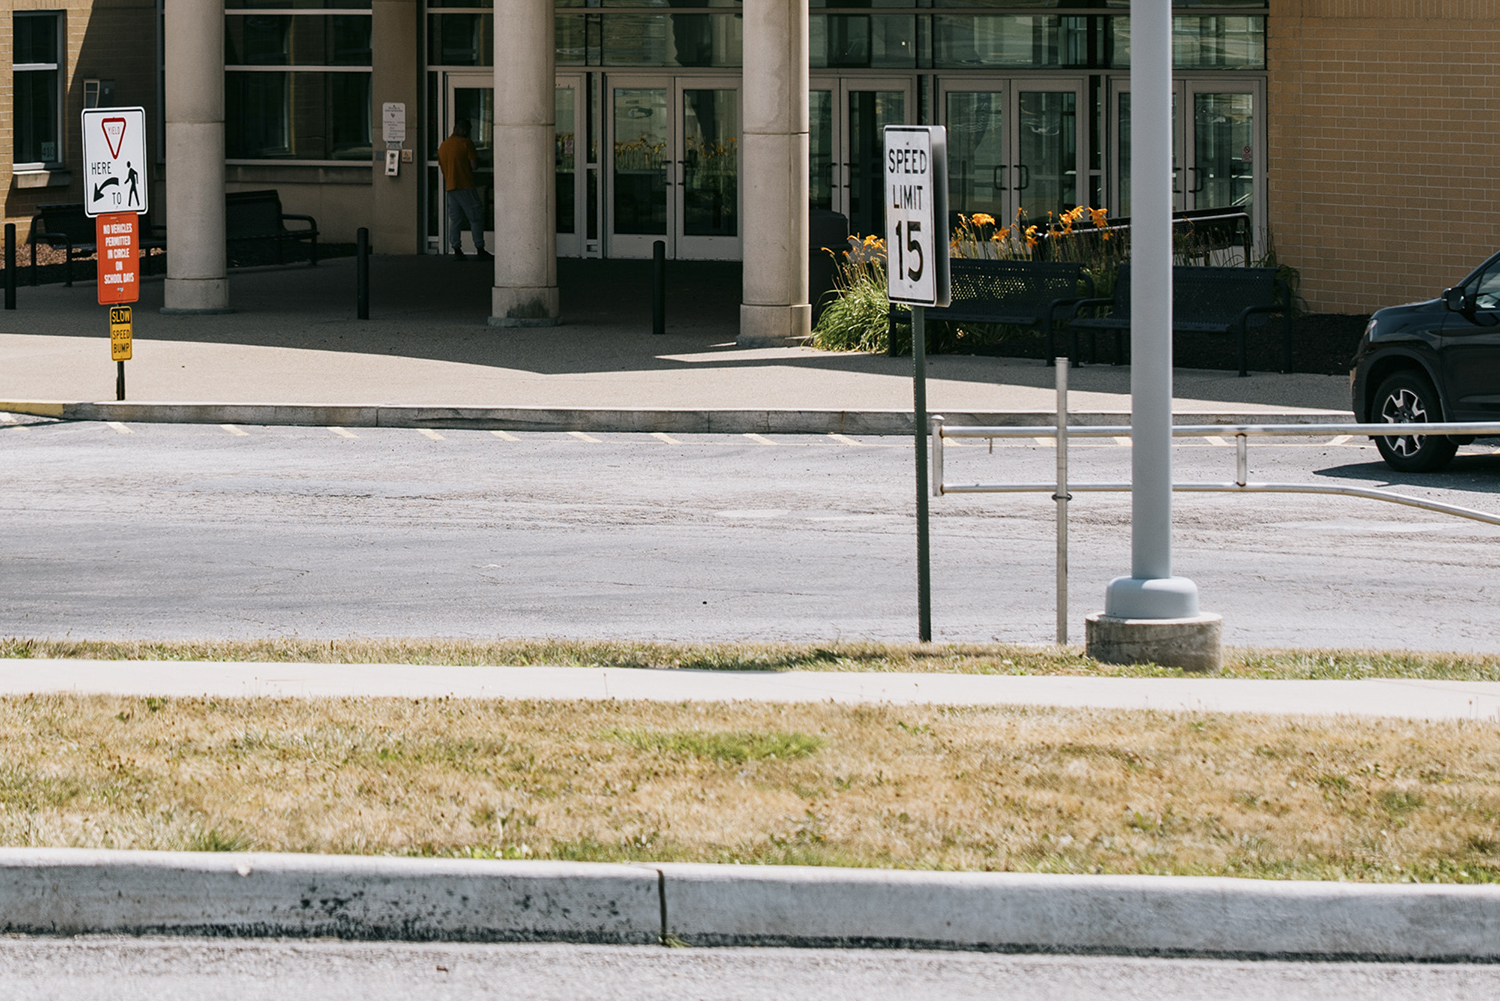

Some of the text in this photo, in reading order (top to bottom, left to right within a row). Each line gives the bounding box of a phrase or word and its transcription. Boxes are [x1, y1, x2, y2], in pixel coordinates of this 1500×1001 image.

[108, 126, 120, 135] YIELD
[888, 148, 927, 175] SPEED
[91, 161, 112, 175] HERE
[112, 192, 122, 205] TO
[892, 184, 923, 210] LIMIT
[103, 223, 133, 235] NO VEHICLES
[105, 235, 131, 247] PERMITTED
[107, 248, 130, 259] IN CIRCLE
[895, 220, 924, 283] 15
[115, 261, 123, 271] ON
[104, 272, 134, 285] SCHOOL DAYS
[112, 310, 130, 323] SLOW
[112, 329, 130, 340] SPEED
[113, 342, 130, 353] BUMP
